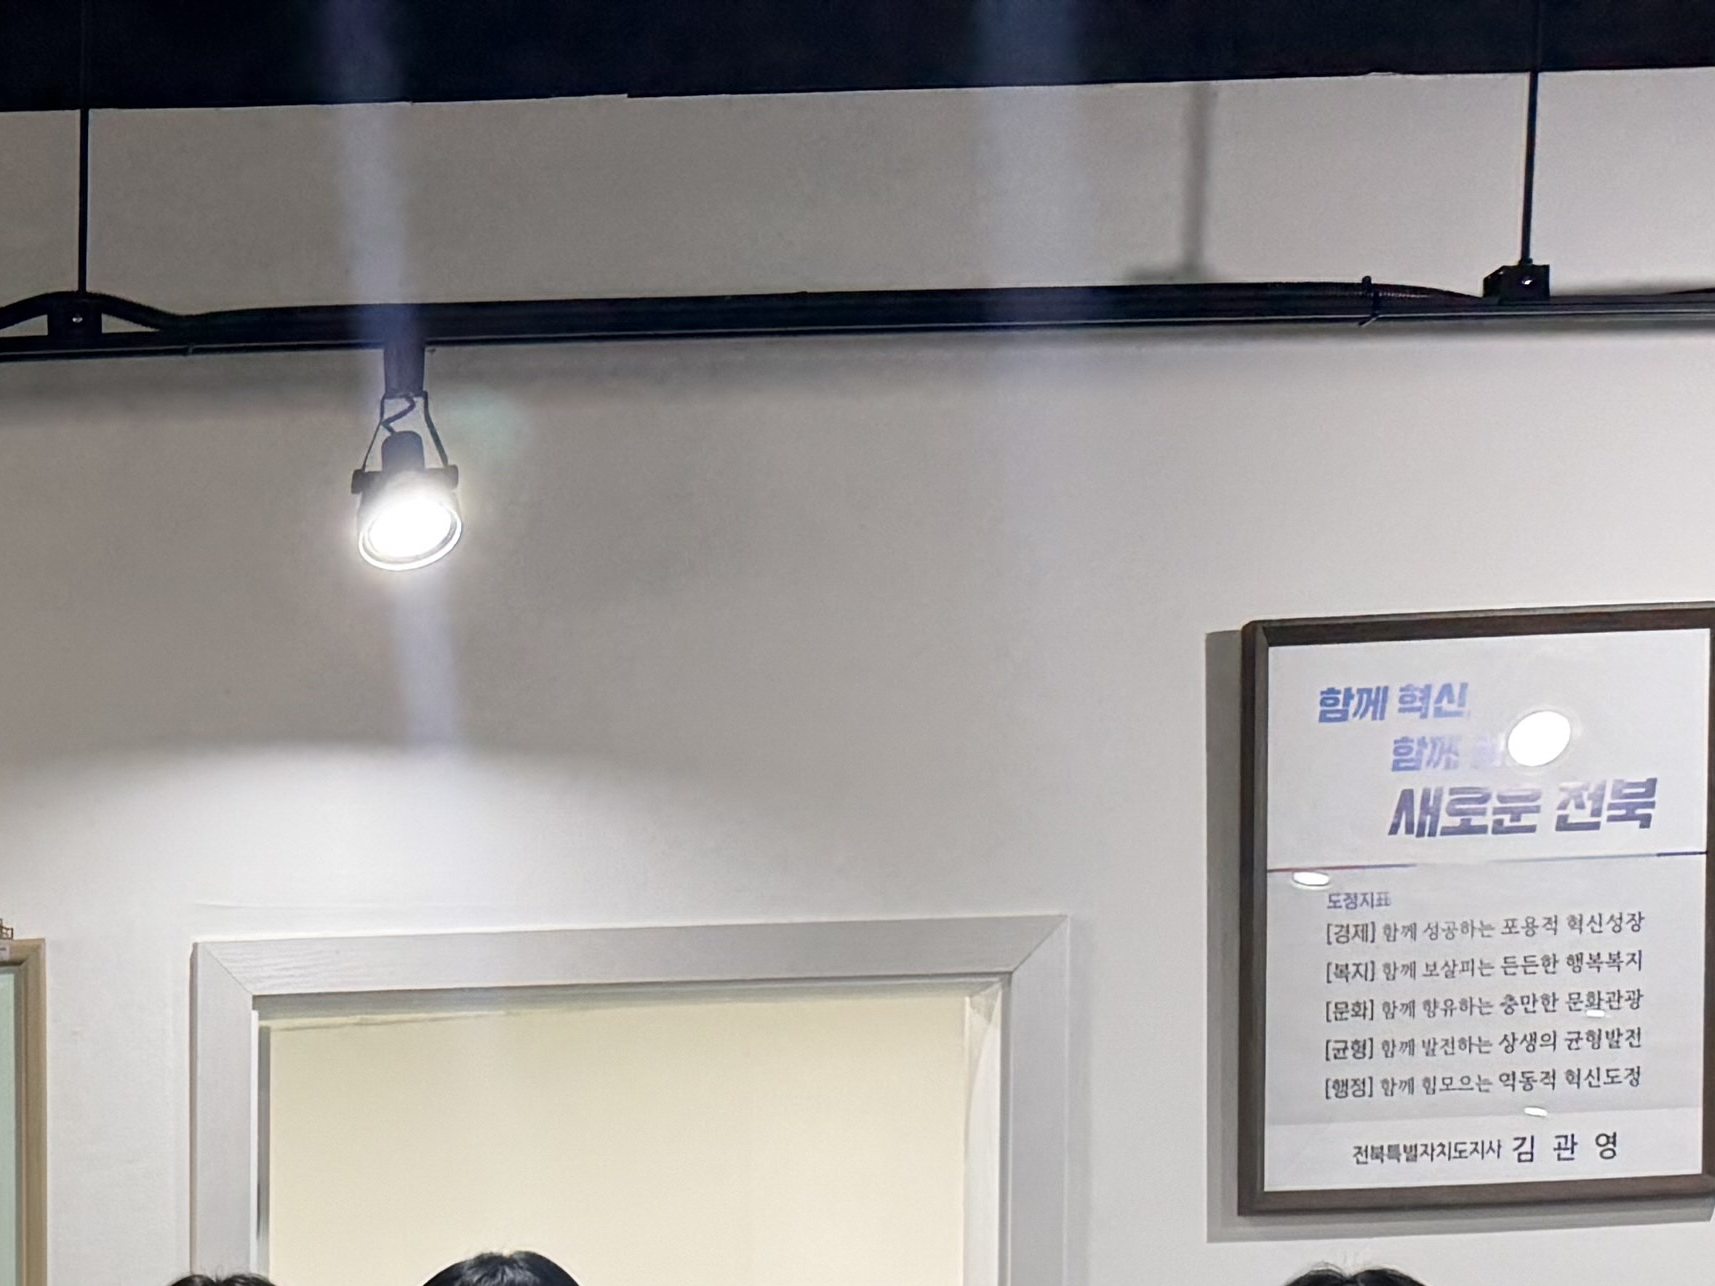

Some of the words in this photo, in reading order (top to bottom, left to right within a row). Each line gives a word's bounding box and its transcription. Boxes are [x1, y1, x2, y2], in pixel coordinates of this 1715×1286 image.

[1318, 686, 1389, 723] 함께
[1388, 786, 1543, 838] 새로운
[1555, 777, 1658, 832] 전북
[1326, 891, 1392, 910] 도정지표
[1326, 921, 1376, 945] [경제]
[1383, 922, 1417, 942] 함께
[1423, 918, 1495, 941] 성공하는
[1501, 915, 1558, 937] 포용적
[1566, 911, 1645, 935] 혁신성장
[1326, 960, 1375, 983] [복지]
[1382, 961, 1416, 981] 함께
[1422, 958, 1495, 979] 보살피는
[1501, 953, 1559, 975] 든든한
[1566, 949, 1643, 974] 행복복지
[1325, 998, 1374, 1023] [문화]
[1382, 999, 1416, 1020] 함께
[1422, 996, 1494, 1019] 향유하는
[1500, 991, 1559, 1015] 충만한
[1565, 988, 1644, 1012] 문화관광
[1325, 1037, 1374, 1061] [균형]
[1381, 1038, 1415, 1058] 함께
[1421, 1035, 1493, 1057] 발전하는
[1499, 1030, 1557, 1054] 상생의
[1564, 1026, 1642, 1051] 균형발전
[1325, 1076, 1374, 1100] [행정]
[1381, 1076, 1415, 1097] 함께
[1422, 1074, 1493, 1095] 힘모으는
[1498, 1069, 1557, 1093] 역동적
[1564, 1065, 1641, 1089] 혁신도정
[1352, 1139, 1502, 1165] 전북특별자치도지사
